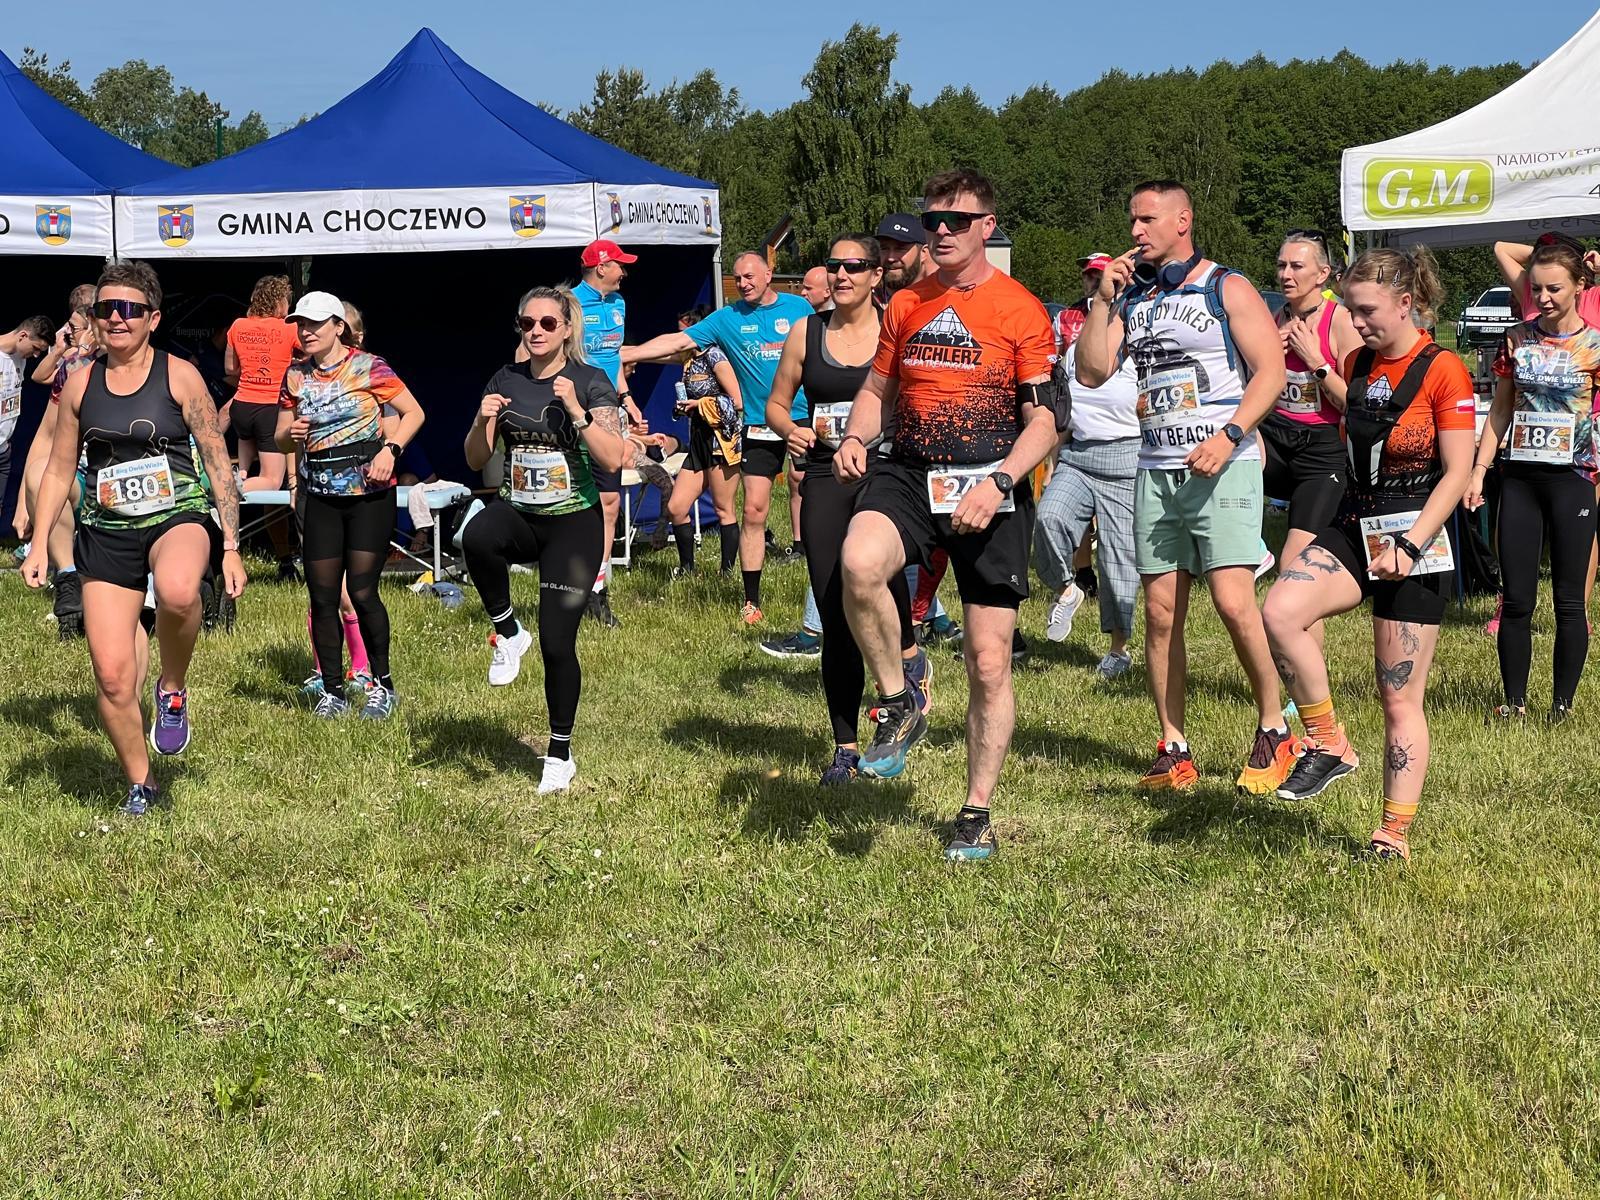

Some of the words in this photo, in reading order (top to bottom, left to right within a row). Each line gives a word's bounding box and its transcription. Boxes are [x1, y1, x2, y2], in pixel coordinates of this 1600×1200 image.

[1377, 168, 1480, 209] G.M.
[217, 212, 314, 236] GMINA
[323, 206, 486, 232] CHOCZEWO
[628, 202, 654, 224] GMINA
[656, 202, 700, 225] CHOCZEWO
[1172, 303, 1215, 333] LIKES
[903, 346, 983, 366] SPICHLERZ
[925, 360, 976, 371] TRENINGOWA
[1519, 373, 1535, 381] BIEG
[1538, 375, 1559, 383] DWIE
[6, 398, 14, 410] 47
[318, 404, 336, 412] DWIE
[1147, 387, 1185, 414] 149
[511, 432, 558, 444] TEAM
[1166, 424, 1215, 447] BEACH
[1521, 427, 1561, 448] 186
[111, 475, 160, 503] 180
[524, 469, 549, 490] 15
[943, 476, 977, 500] 24
